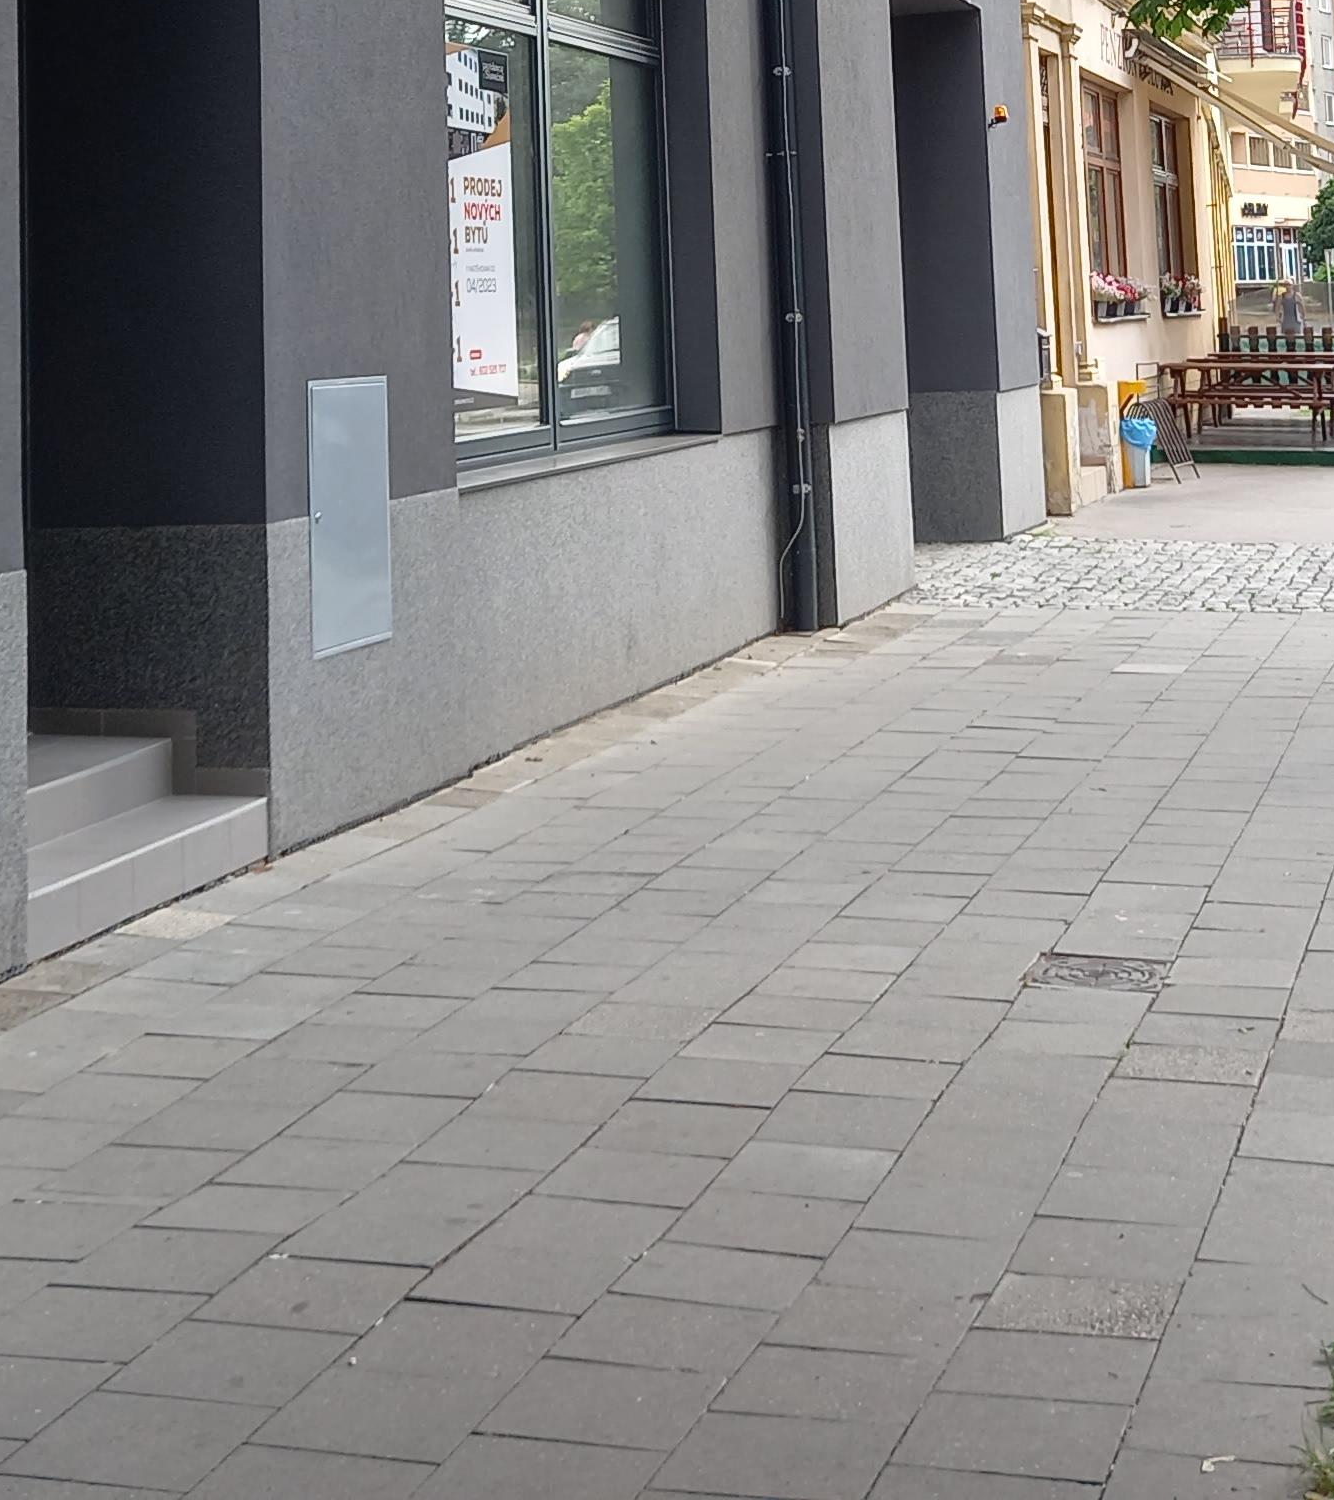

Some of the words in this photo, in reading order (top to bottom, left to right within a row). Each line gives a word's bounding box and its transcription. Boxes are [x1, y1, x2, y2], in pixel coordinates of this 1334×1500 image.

[463, 176, 503, 197] PRODEJ
[463, 198, 502, 221] NOVÝCH
[465, 220, 488, 244] BYTŮ
[466, 277, 498, 294] 04/2023
